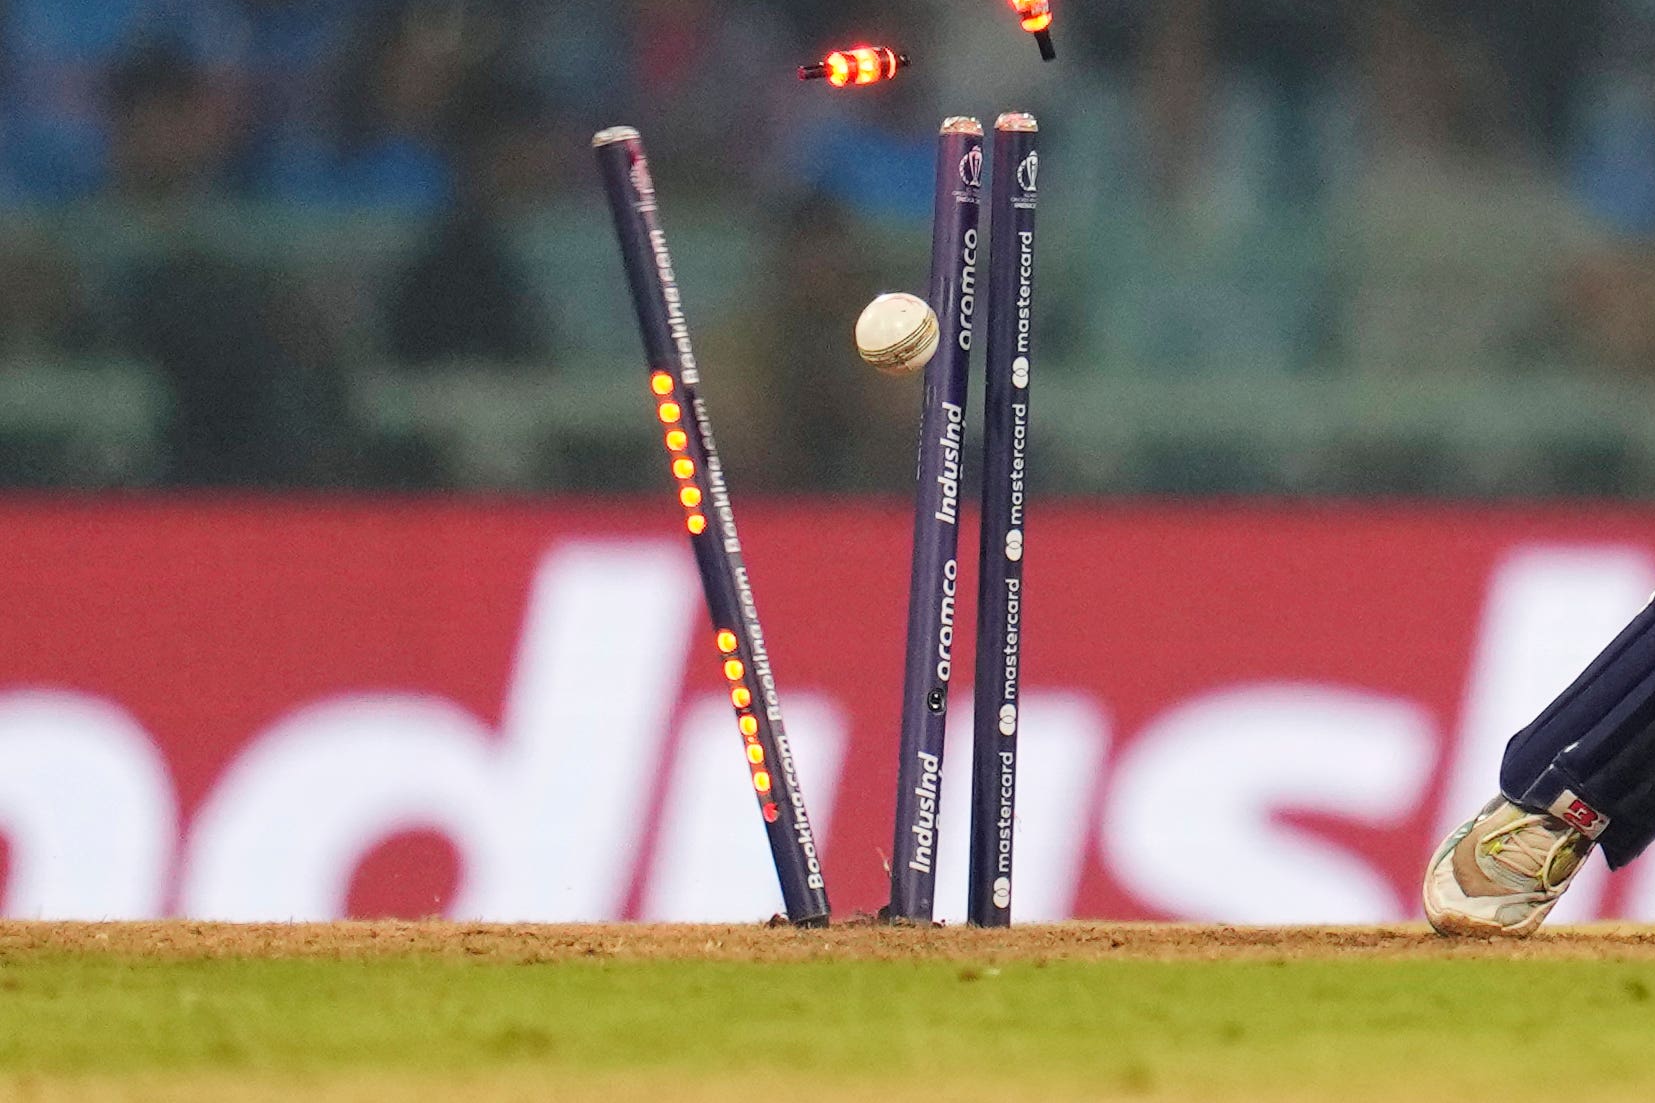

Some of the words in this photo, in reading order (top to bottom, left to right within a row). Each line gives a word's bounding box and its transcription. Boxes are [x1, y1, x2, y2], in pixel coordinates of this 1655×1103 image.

[958, 228, 978, 352] aramco
[1015, 230, 1033, 353] mastercard
[934, 400, 962, 526] IndusInd
[1009, 402, 1027, 526] mastercard
[936, 558, 958, 683] aramco
[1003, 577, 1021, 700] mastercard
[908, 750, 939, 874] IndusInd
[996, 750, 1015, 873] mastercard
